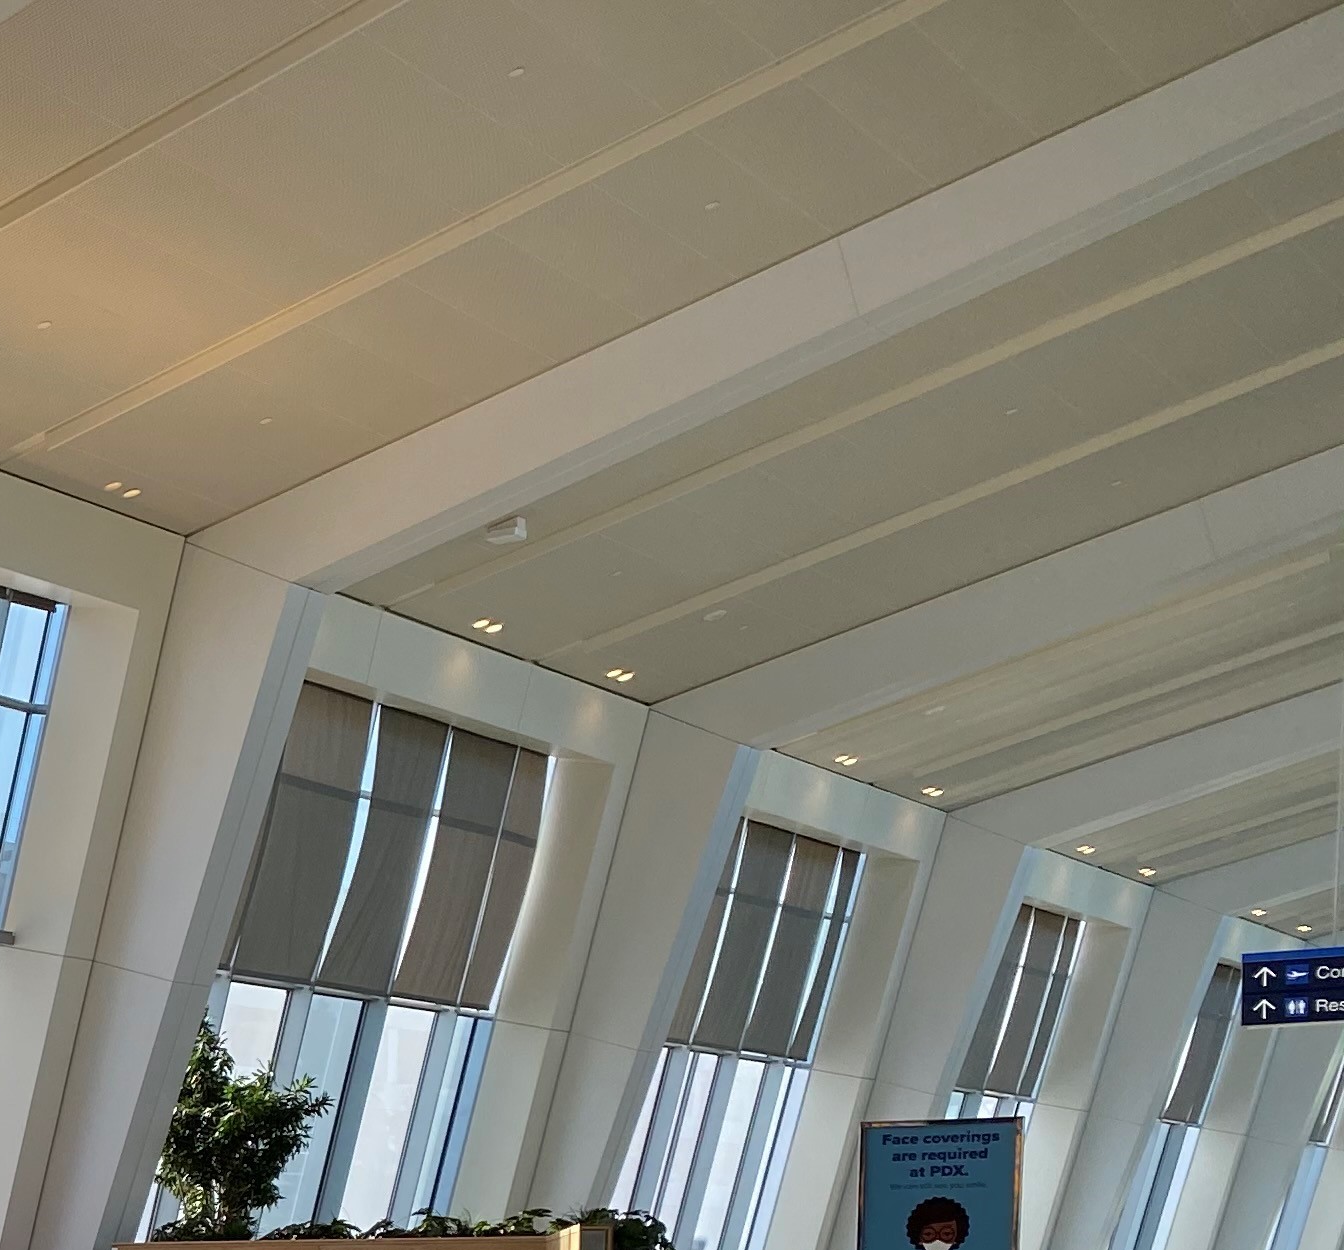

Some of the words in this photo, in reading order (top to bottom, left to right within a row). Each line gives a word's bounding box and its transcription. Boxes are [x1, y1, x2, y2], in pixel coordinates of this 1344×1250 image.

[882, 1133, 918, 1145] Face
[923, 1130, 1001, 1145] coverings
[891, 1151, 917, 1162] are
[921, 1147, 989, 1163] required
[909, 1166, 926, 1178] at
[930, 1164, 969, 1177] PDX.
